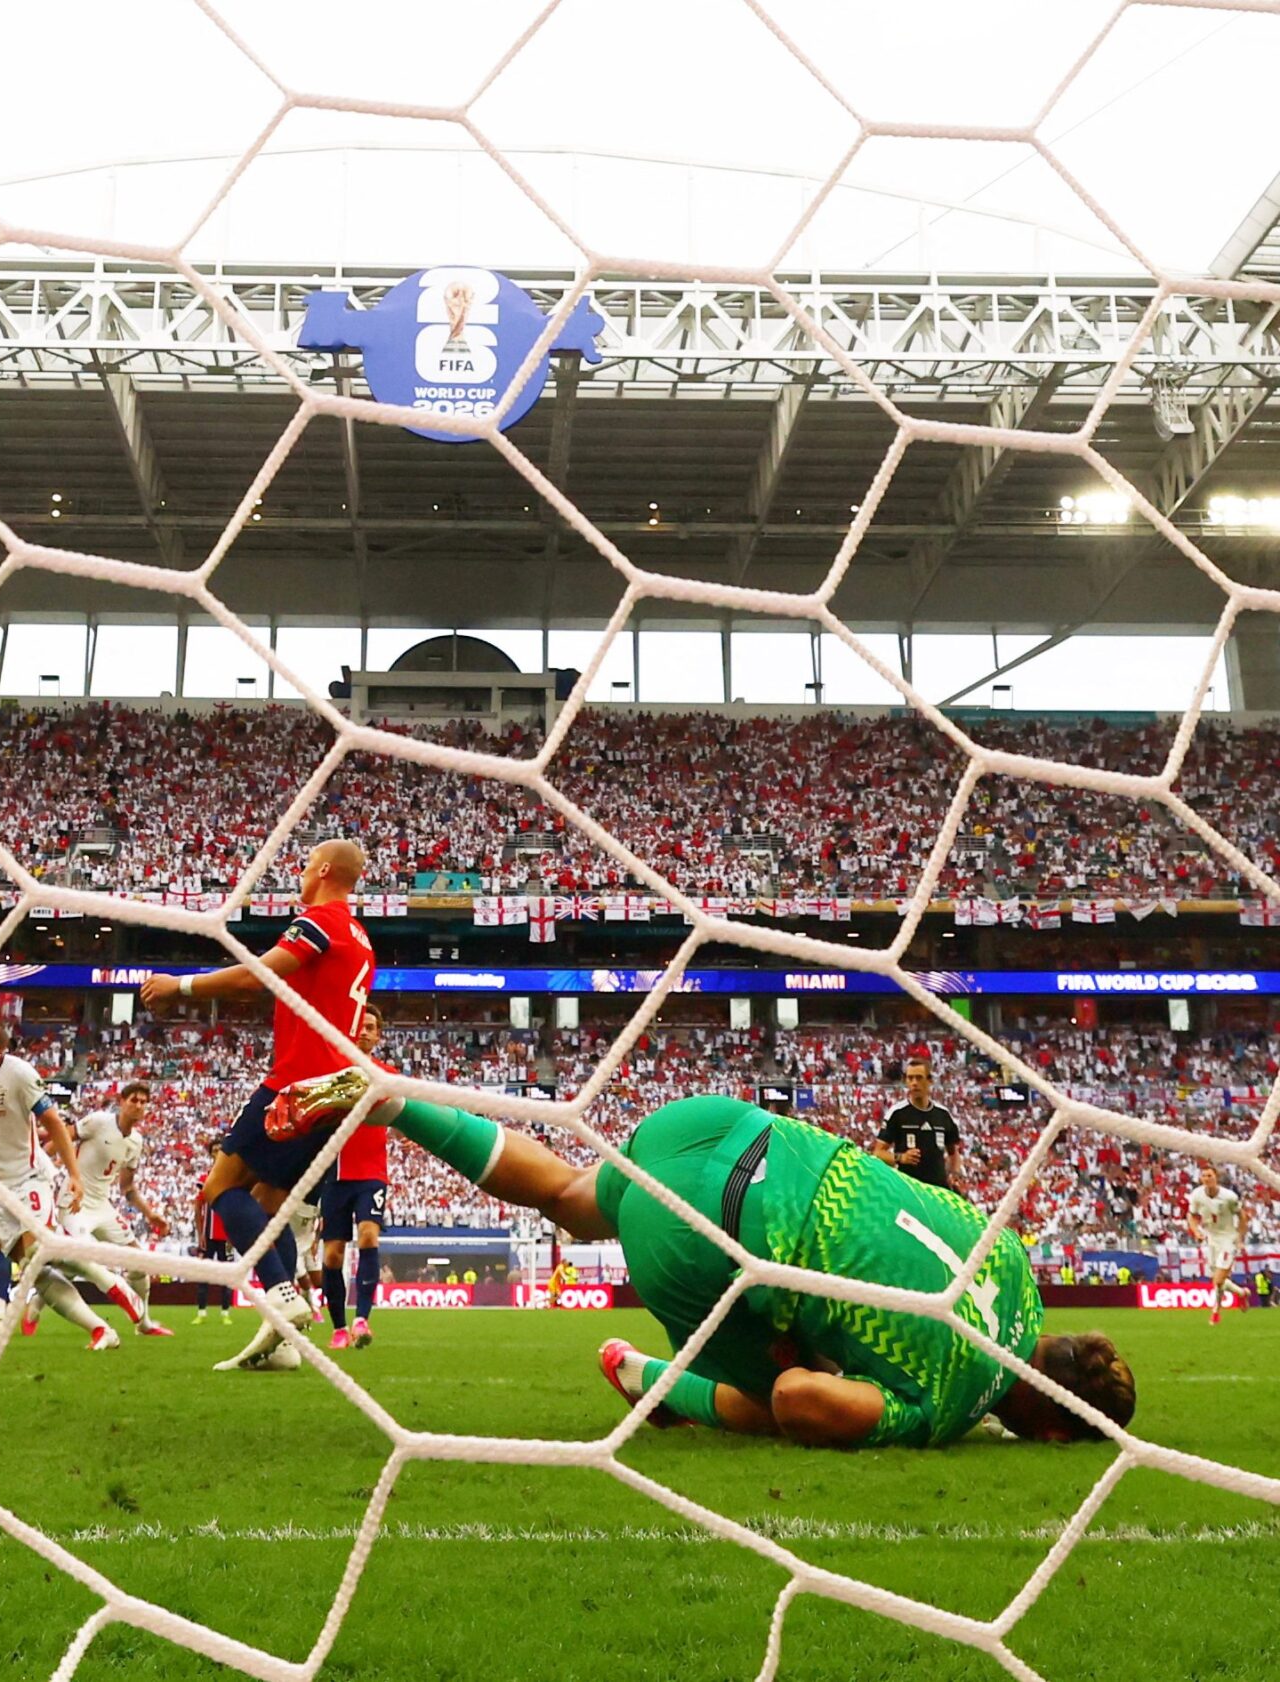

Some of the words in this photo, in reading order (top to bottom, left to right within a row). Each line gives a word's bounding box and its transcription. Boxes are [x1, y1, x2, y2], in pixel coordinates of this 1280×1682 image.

[439, 360, 475, 372] FIFA
[414, 387, 466, 399] WORLD
[467, 388, 496, 400] CUP
[413, 401, 496, 418] 2026
[785, 974, 846, 990] MIAMI
[1057, 974, 1097, 990] FIFA
[1096, 974, 1158, 990] WORLD
[1159, 974, 1194, 990] CUP
[348, 959, 370, 1037] 4
[28, 1190, 40, 1211] 9
[373, 1188, 385, 1208] 6
